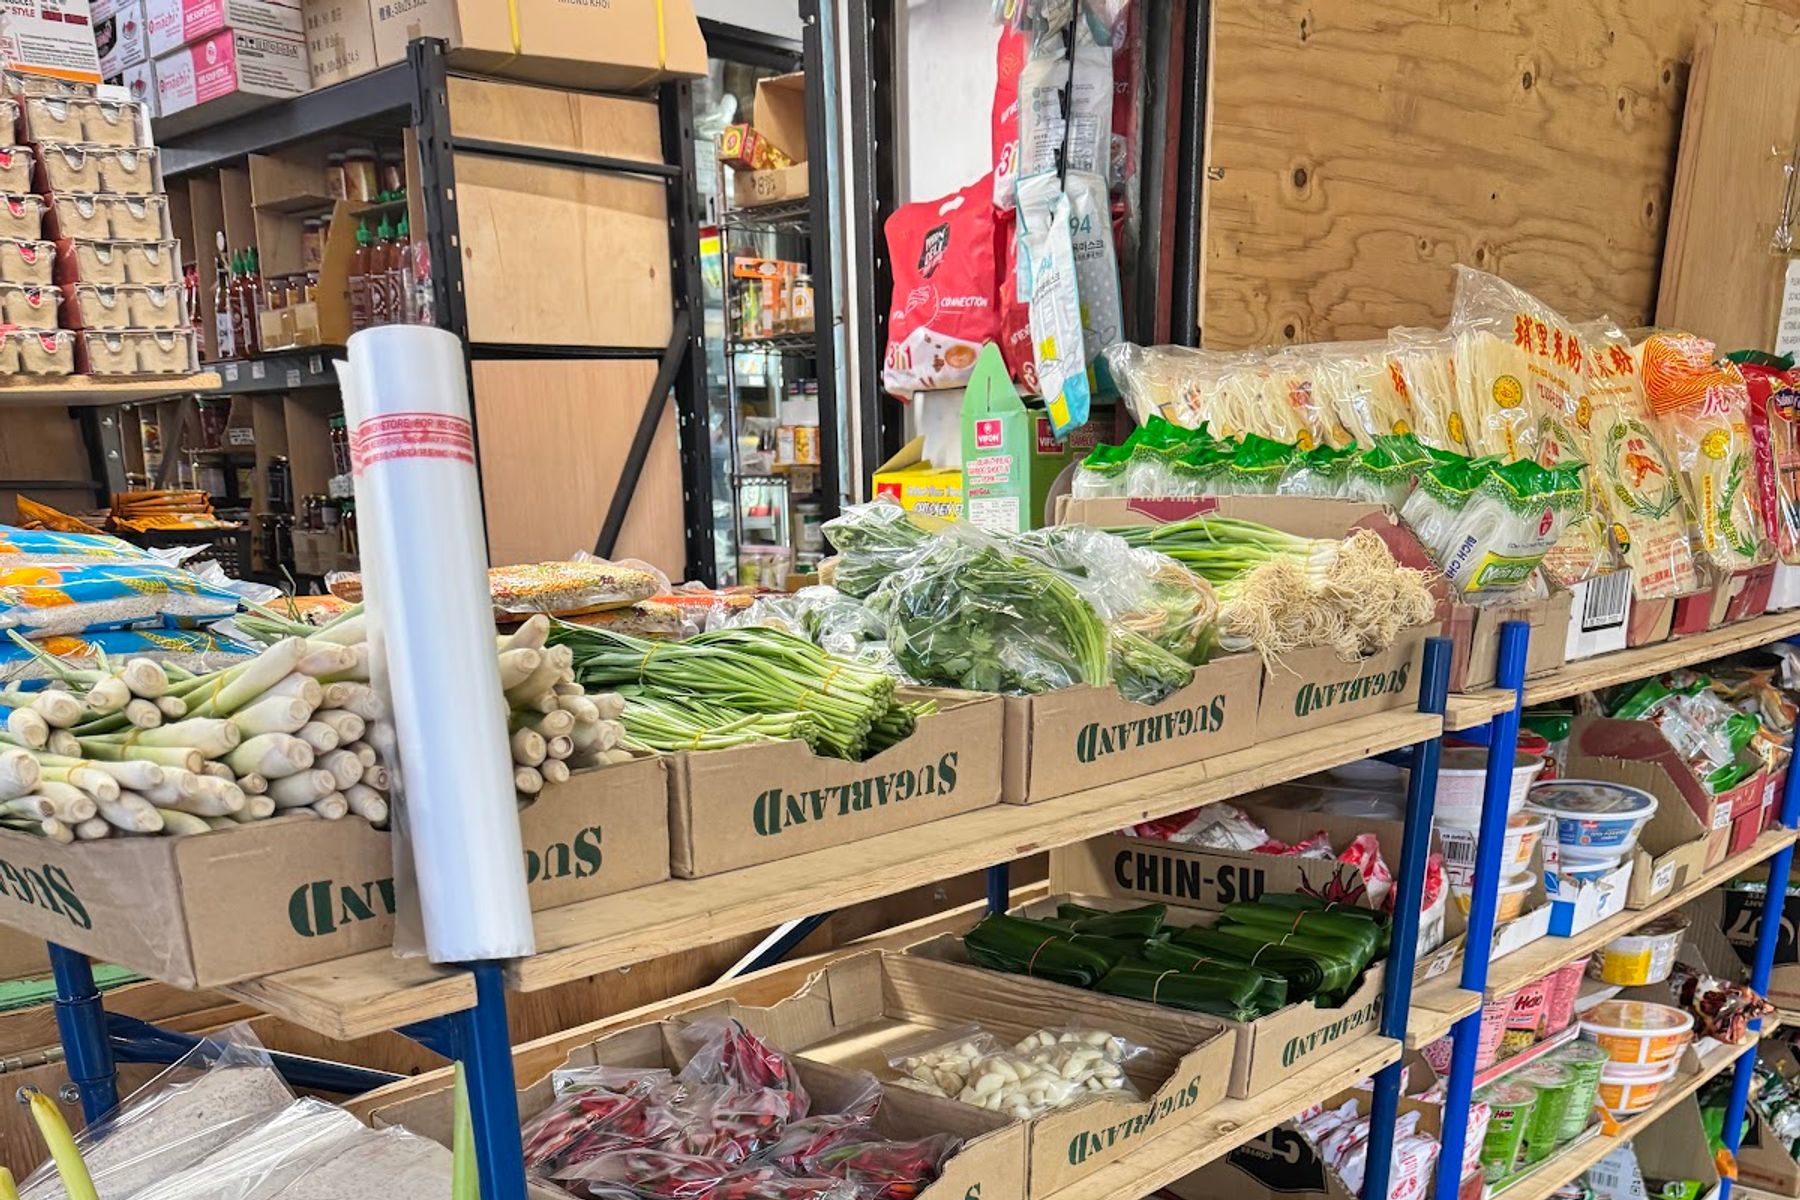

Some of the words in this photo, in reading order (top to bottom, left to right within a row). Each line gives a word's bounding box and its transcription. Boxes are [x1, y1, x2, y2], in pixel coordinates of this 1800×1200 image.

[12, 6, 36, 18] STYLE
[940, 296, 988, 308] CONNECTION
[978, 434, 1000, 443] VIFON
[1294, 661, 1412, 717] SUGARLAND
[1077, 694, 1226, 765] SUGARLAND
[753, 750, 958, 837] SUGARLAND
[1114, 850, 1264, 903] CHIN-SU
[1282, 992, 1383, 1068] SUGARLAND
[1069, 1075, 1200, 1165] SUGARLAND
